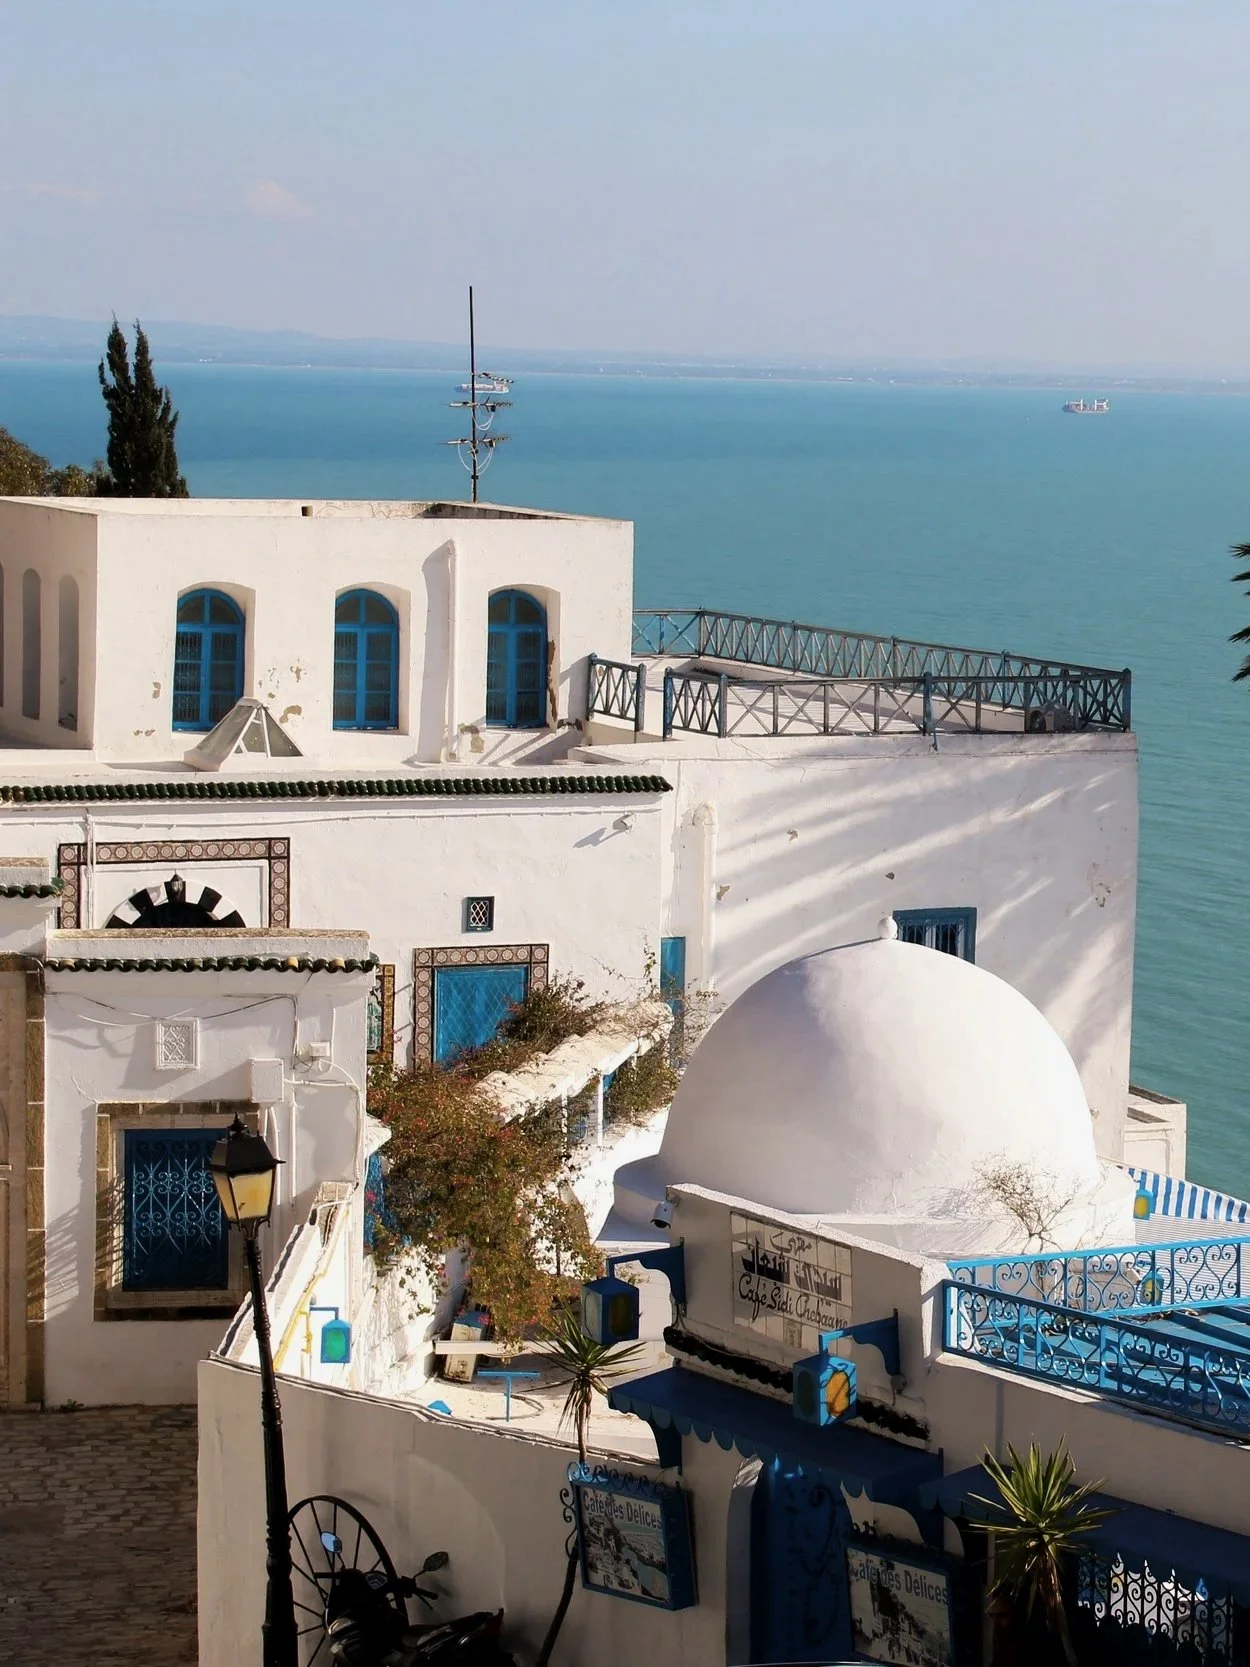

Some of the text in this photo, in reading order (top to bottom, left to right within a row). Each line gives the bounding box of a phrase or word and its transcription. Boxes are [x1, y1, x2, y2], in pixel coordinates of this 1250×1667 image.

[738, 1273, 767, 1322] Café
[766, 1286, 793, 1315] Sidi
[626, 1501, 663, 1529] Délices
[880, 1562, 901, 1590] des
[904, 1570, 949, 1604] Délices
